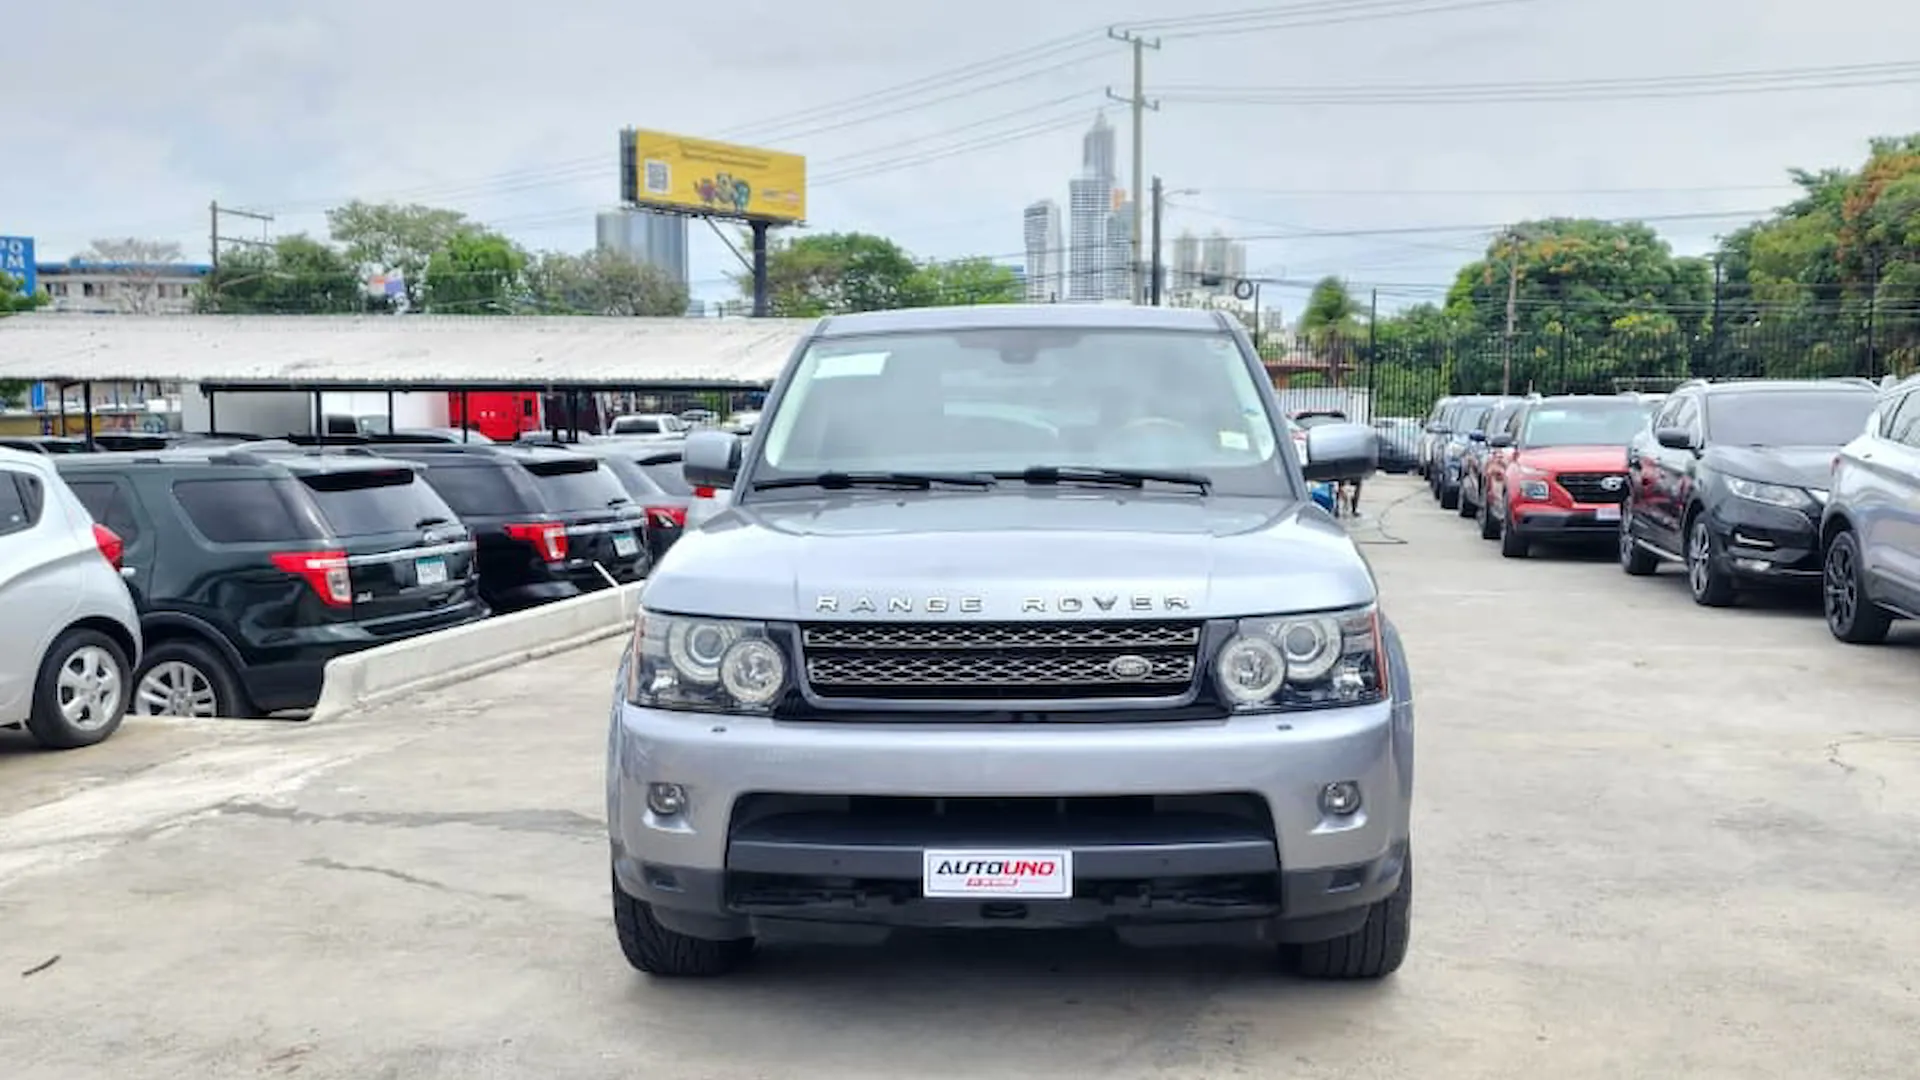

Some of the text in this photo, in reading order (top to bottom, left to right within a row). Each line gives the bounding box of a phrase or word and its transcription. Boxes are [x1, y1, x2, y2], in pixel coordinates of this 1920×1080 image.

[816, 594, 1190, 612] RANGE ROVER
[936, 860, 1055, 876] AUTOUNO
